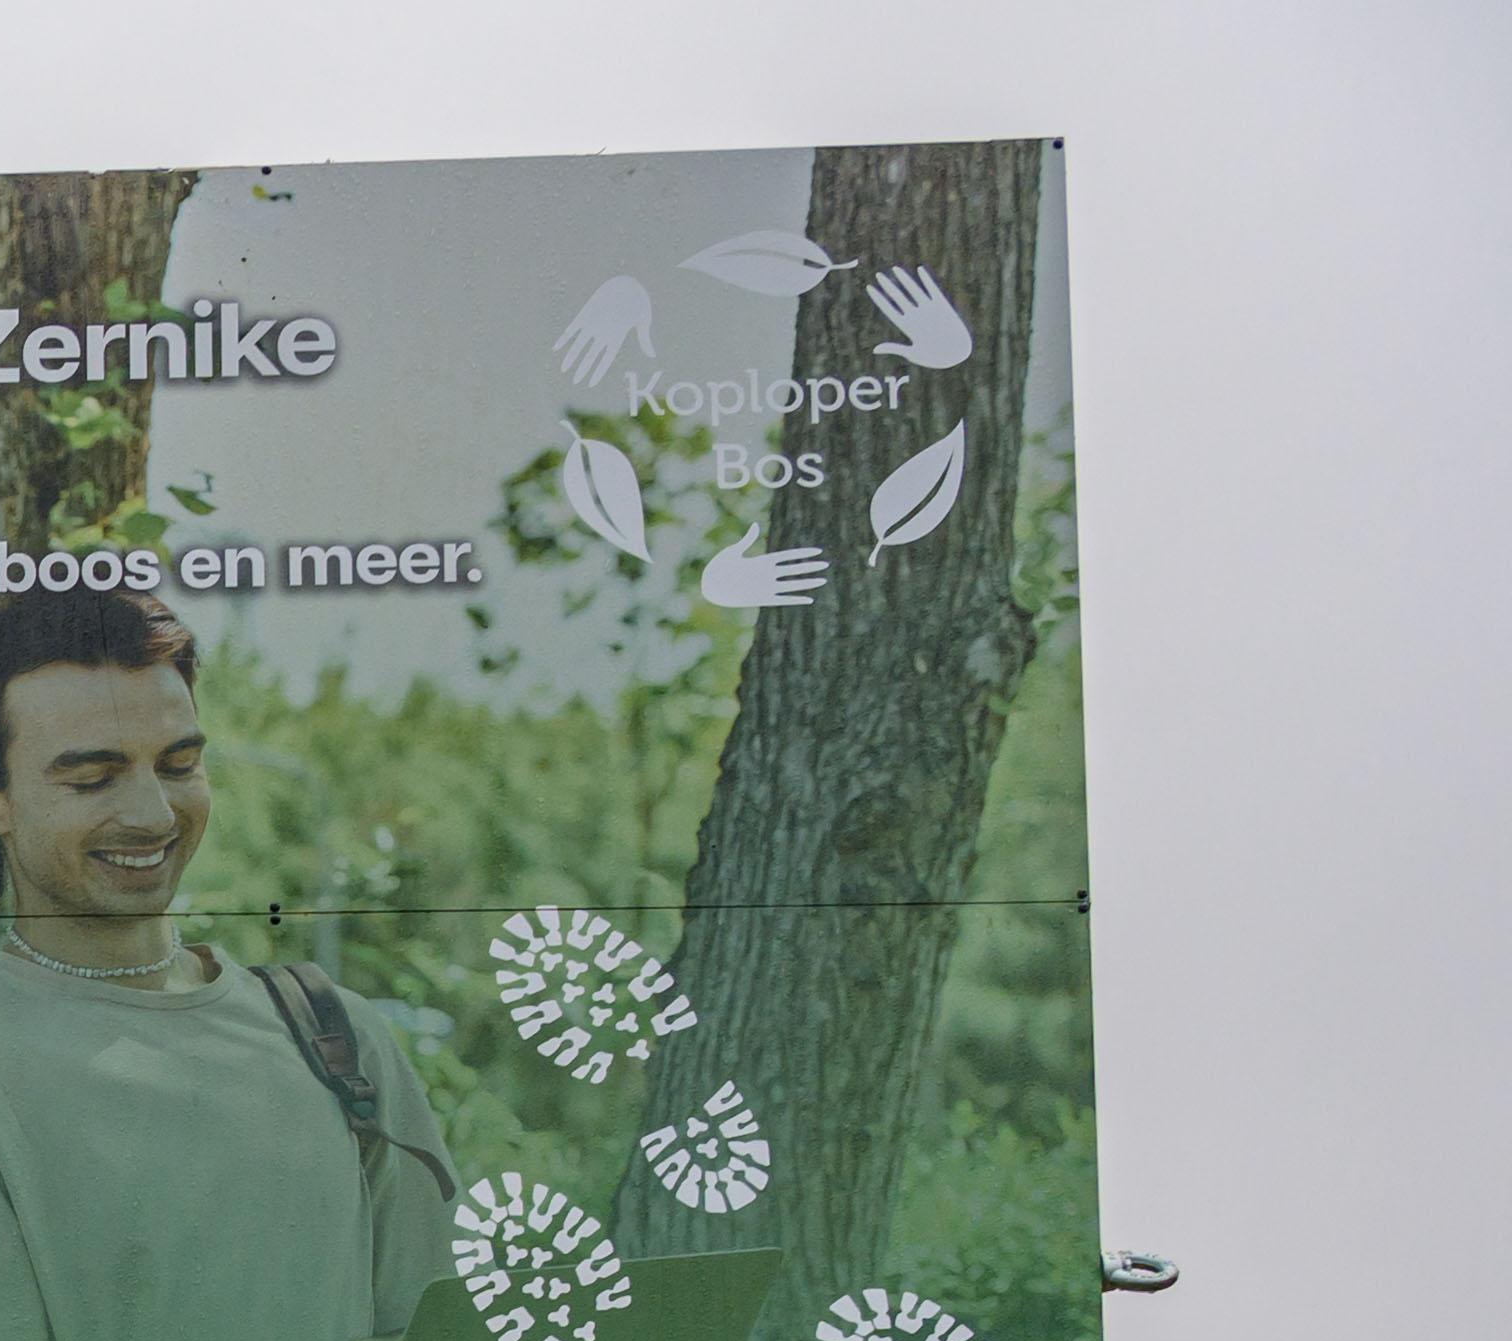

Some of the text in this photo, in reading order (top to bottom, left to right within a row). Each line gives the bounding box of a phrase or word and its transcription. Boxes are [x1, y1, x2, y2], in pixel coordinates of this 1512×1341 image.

[626, 366, 909, 425] Koploper
[715, 442, 824, 490] Bos
[180, 545, 264, 591] en
[288, 536, 483, 589] meer.
